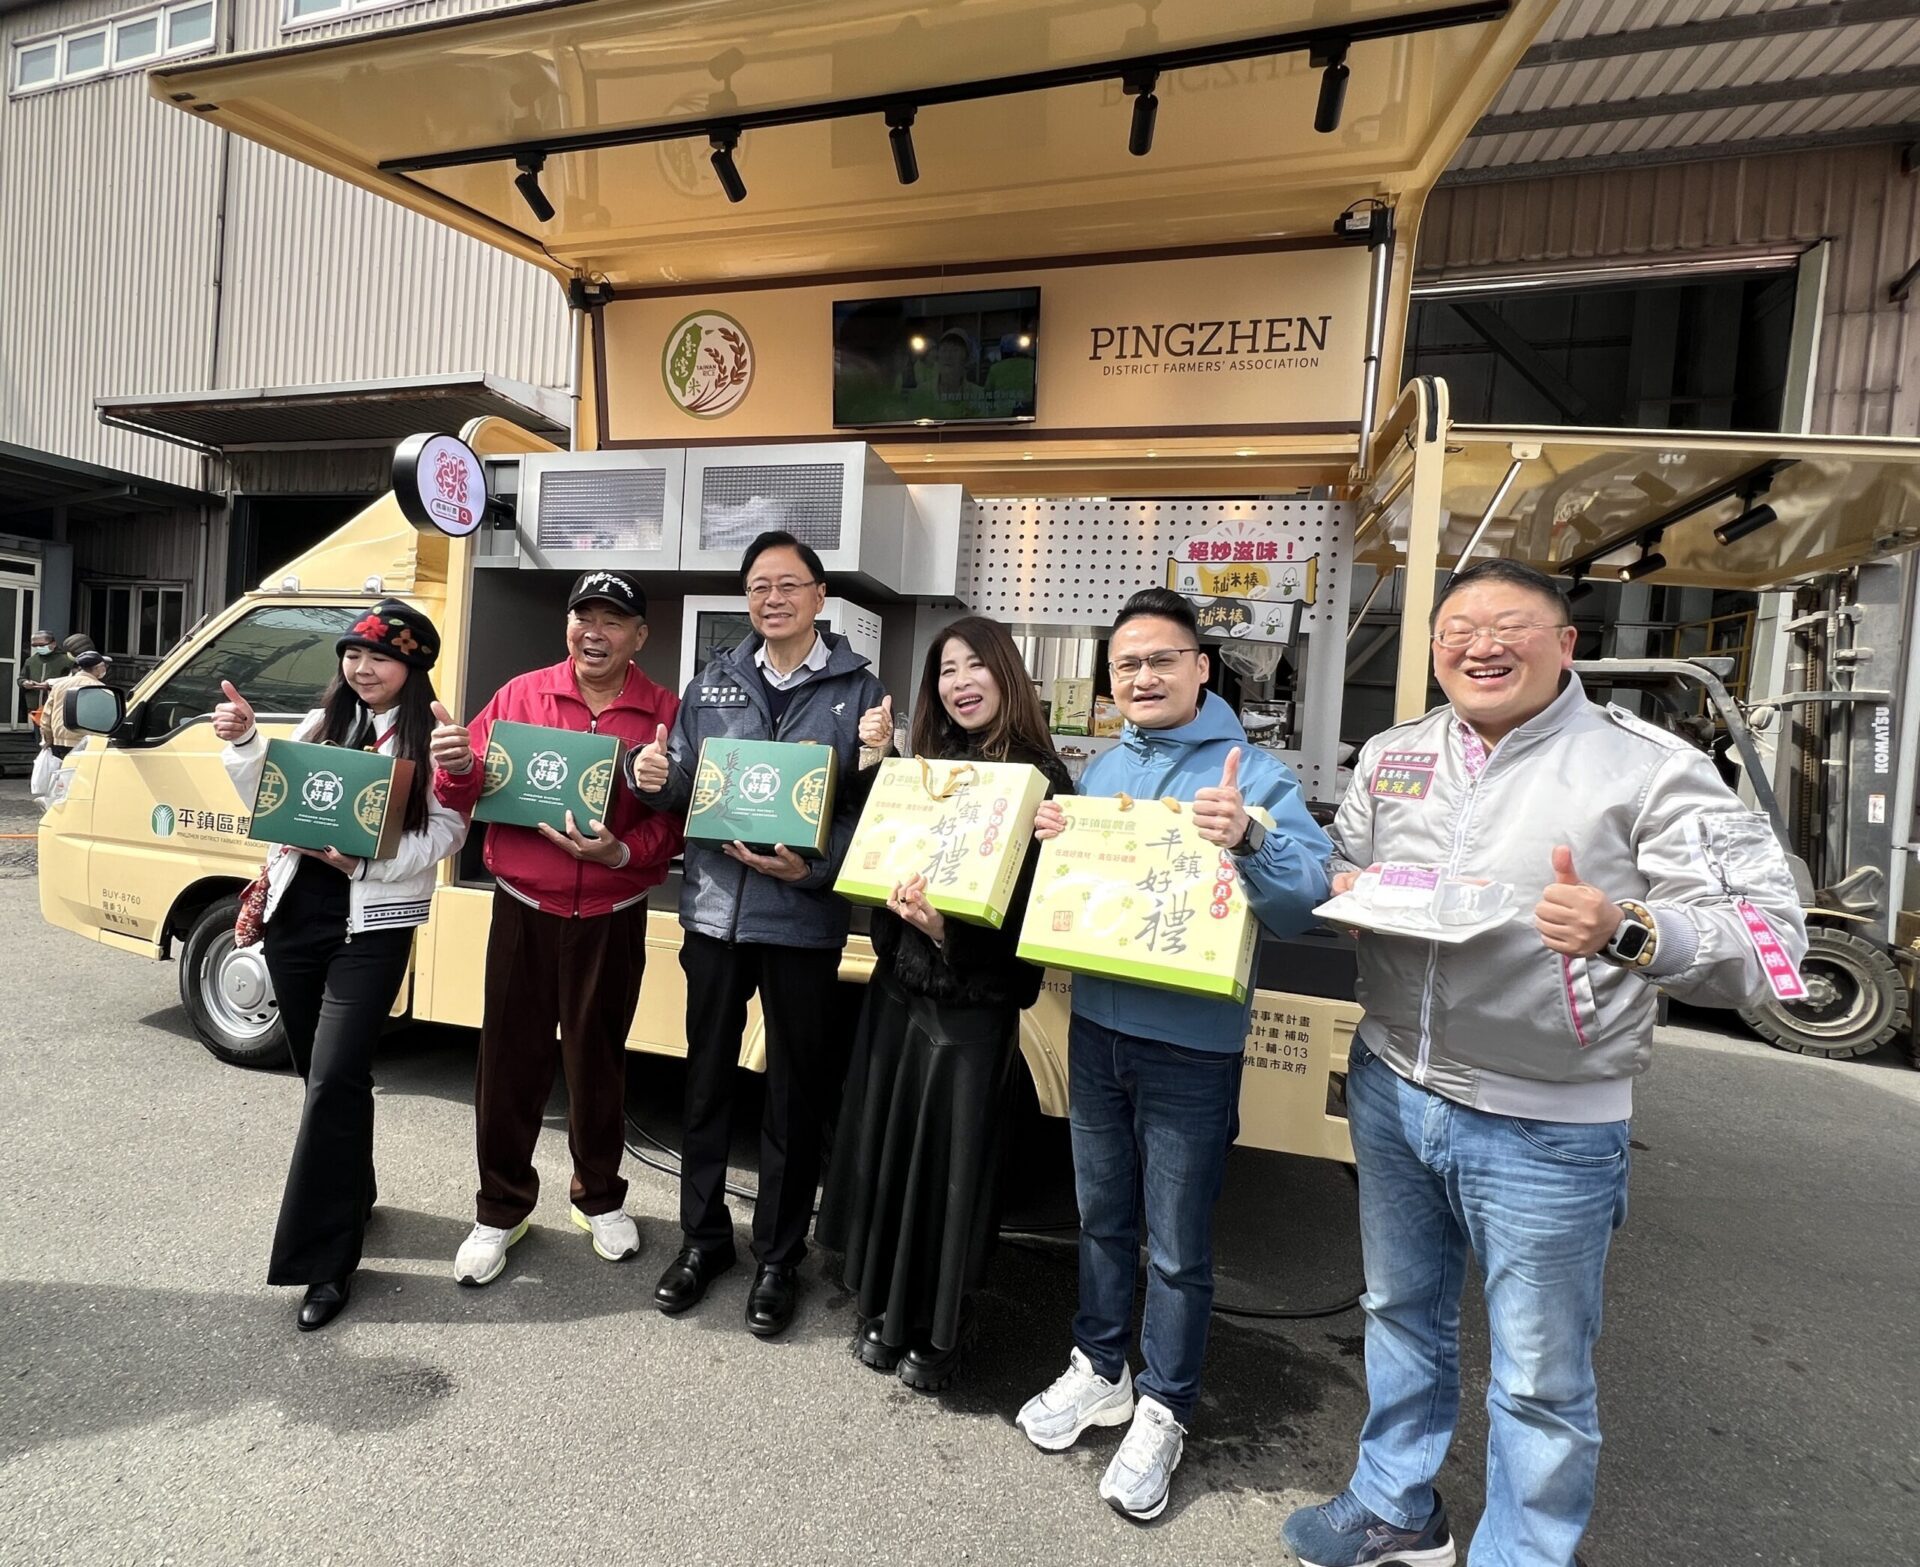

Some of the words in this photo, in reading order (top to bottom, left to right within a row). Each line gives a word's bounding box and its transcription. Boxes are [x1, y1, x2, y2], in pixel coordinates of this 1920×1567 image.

[1089, 316, 1332, 360] PINGZHEN
[1103, 363, 1159, 376] DISTRICT
[1229, 357, 1319, 371] ASSOCIATION
[1871, 706, 1890, 774] KOMATSU
[311, 778, 337, 793] 平安
[102, 888, 141, 905] BUY-8760
[1249, 1024, 1279, 1039] 計畫
[1284, 1029, 1309, 1044] 補助
[1243, 1055, 1308, 1075] 桃園市政府
